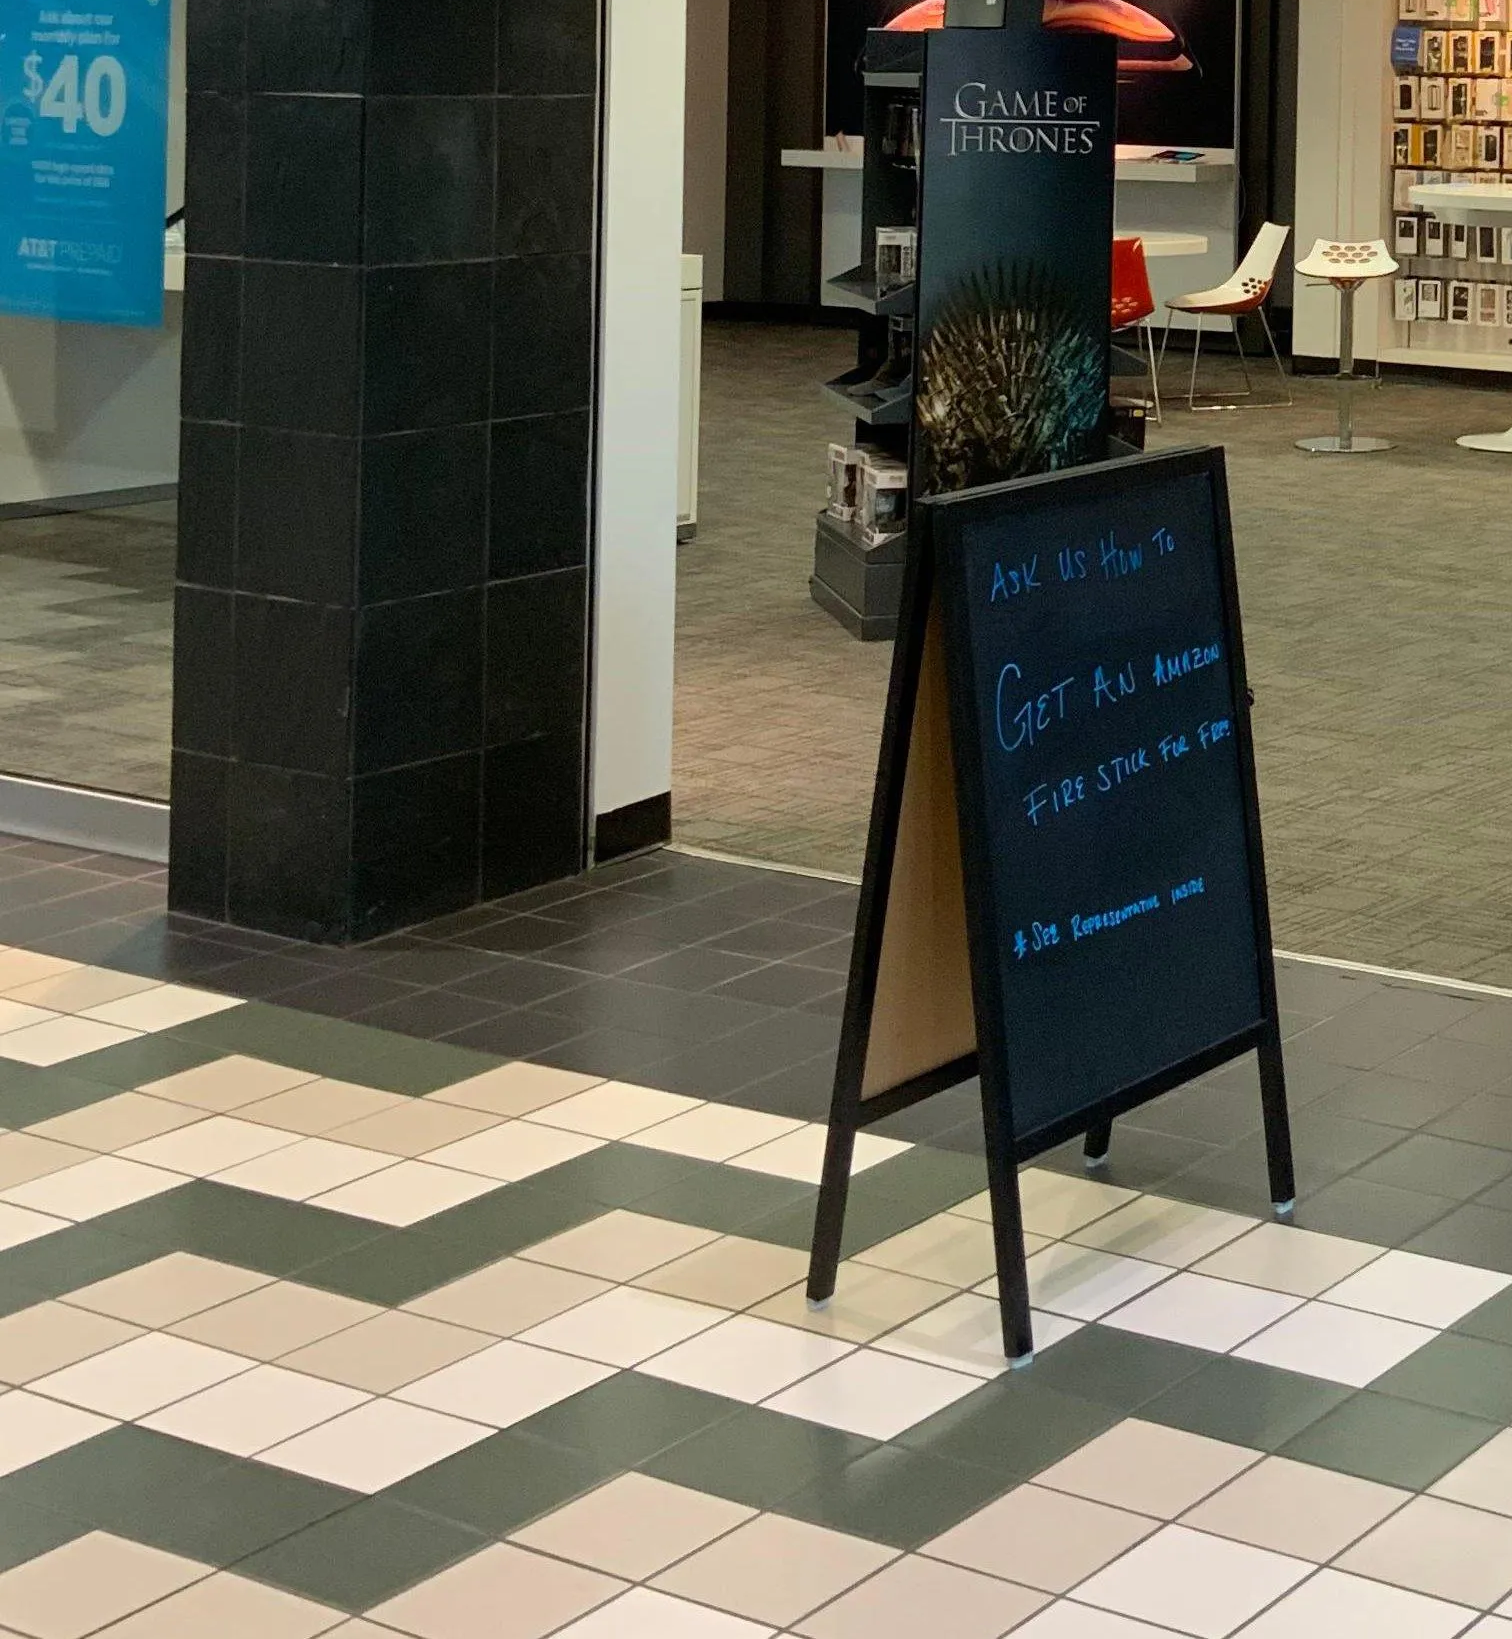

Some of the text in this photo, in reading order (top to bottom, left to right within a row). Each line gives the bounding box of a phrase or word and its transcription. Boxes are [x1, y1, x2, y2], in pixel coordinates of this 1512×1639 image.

[22, 49, 127, 137] $40
[954, 82, 1088, 119] GAME OF
[939, 118, 1100, 156] THRONES
[17, 237, 58, 259] AT&T
[1058, 547, 1087, 581] US
